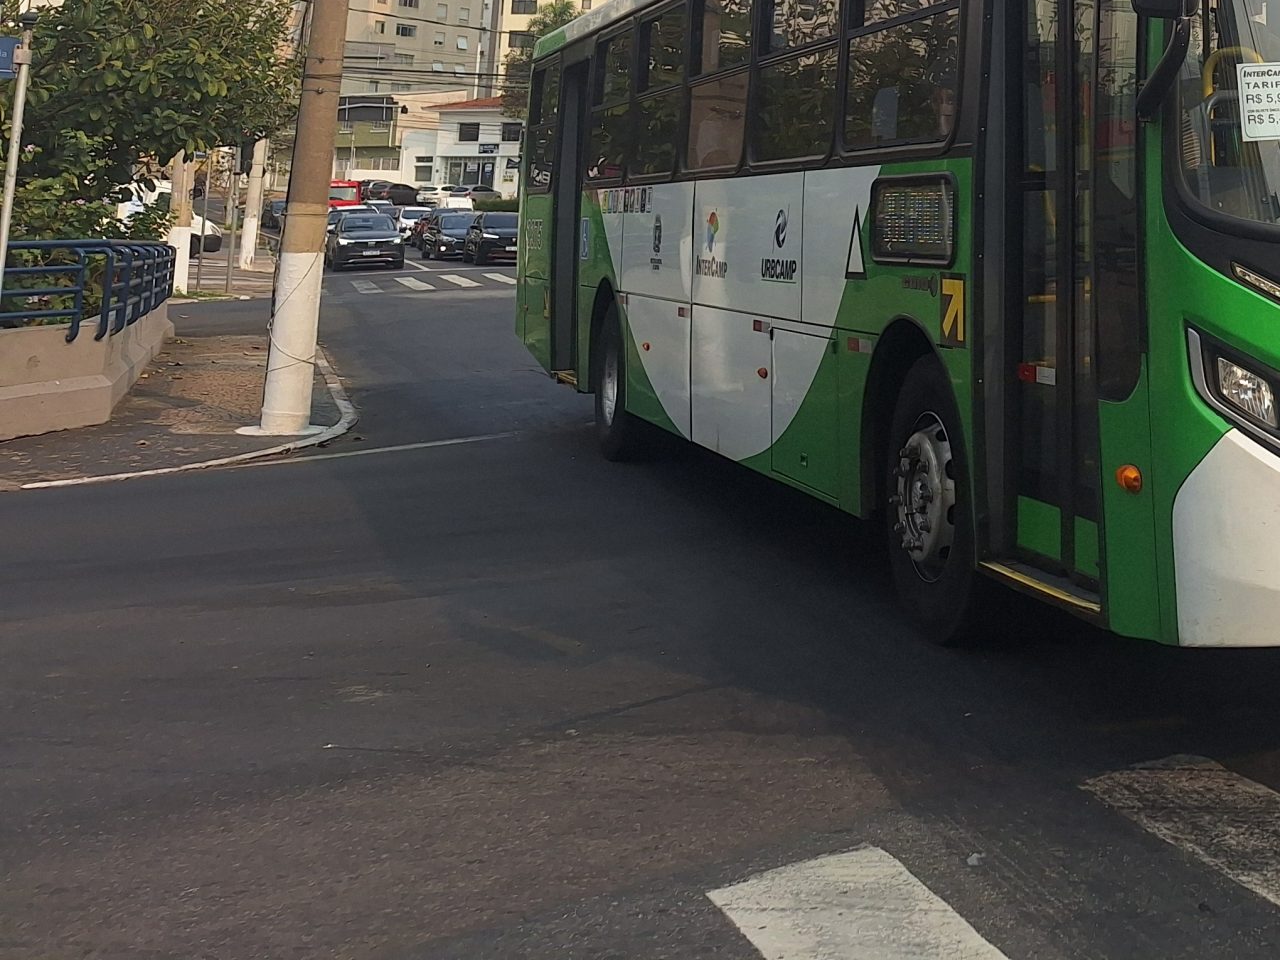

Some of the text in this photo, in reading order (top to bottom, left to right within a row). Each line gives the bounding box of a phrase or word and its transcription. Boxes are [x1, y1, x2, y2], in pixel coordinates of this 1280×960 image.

[1246, 93, 1262, 104] R$
[1248, 113, 1264, 125] R$
[761, 258, 797, 281] URBCAMP
